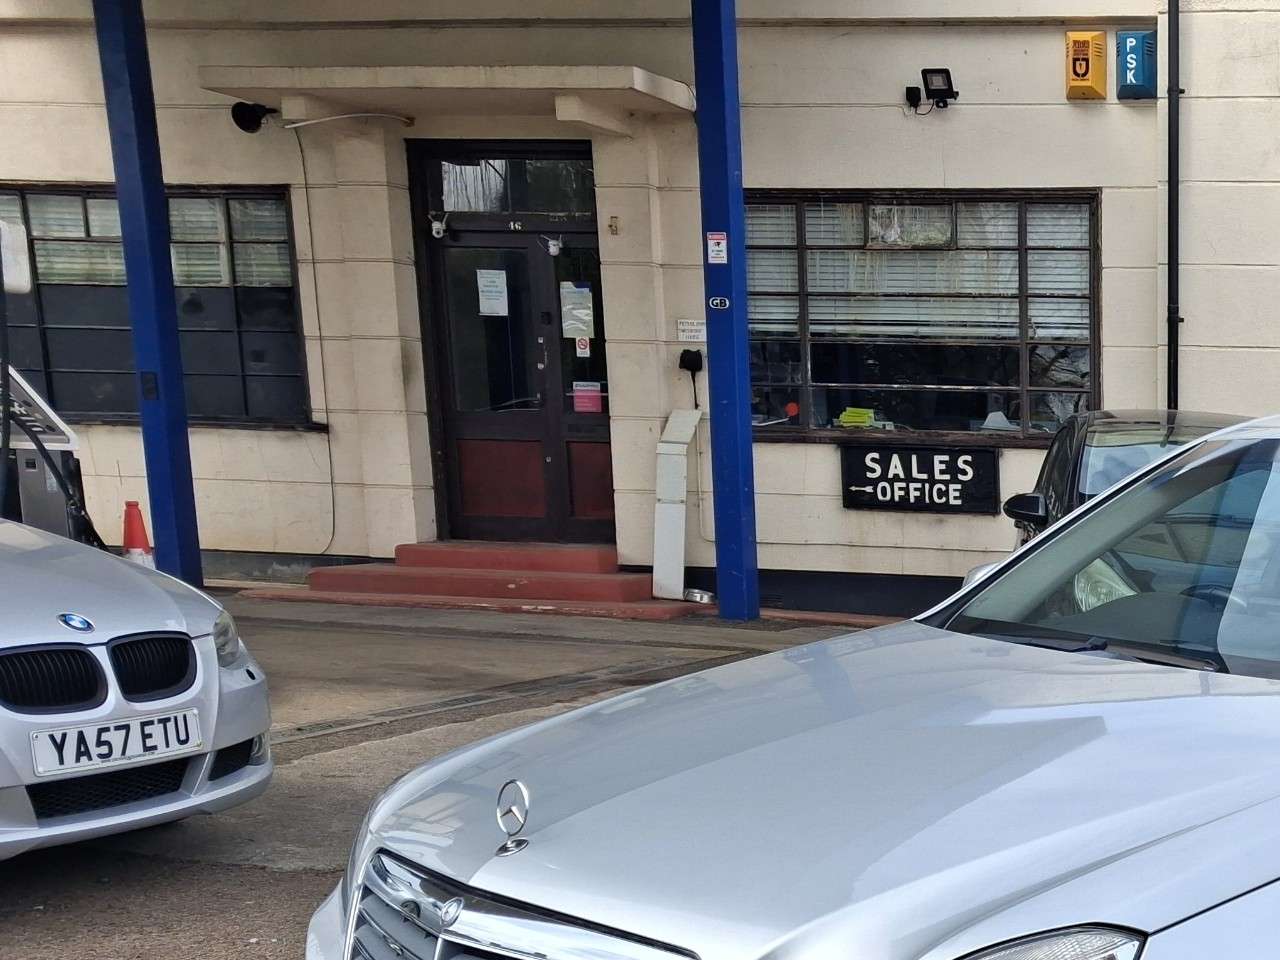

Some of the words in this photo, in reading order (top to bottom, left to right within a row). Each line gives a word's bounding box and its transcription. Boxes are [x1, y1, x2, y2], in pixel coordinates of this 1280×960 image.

[1126, 37, 1137, 84] PSK
[711, 298, 728, 308] GB
[864, 452, 974, 481] SALES
[876, 481, 962, 505] OFFICE
[48, 723, 131, 766] YA57
[139, 713, 190, 753] ETU
